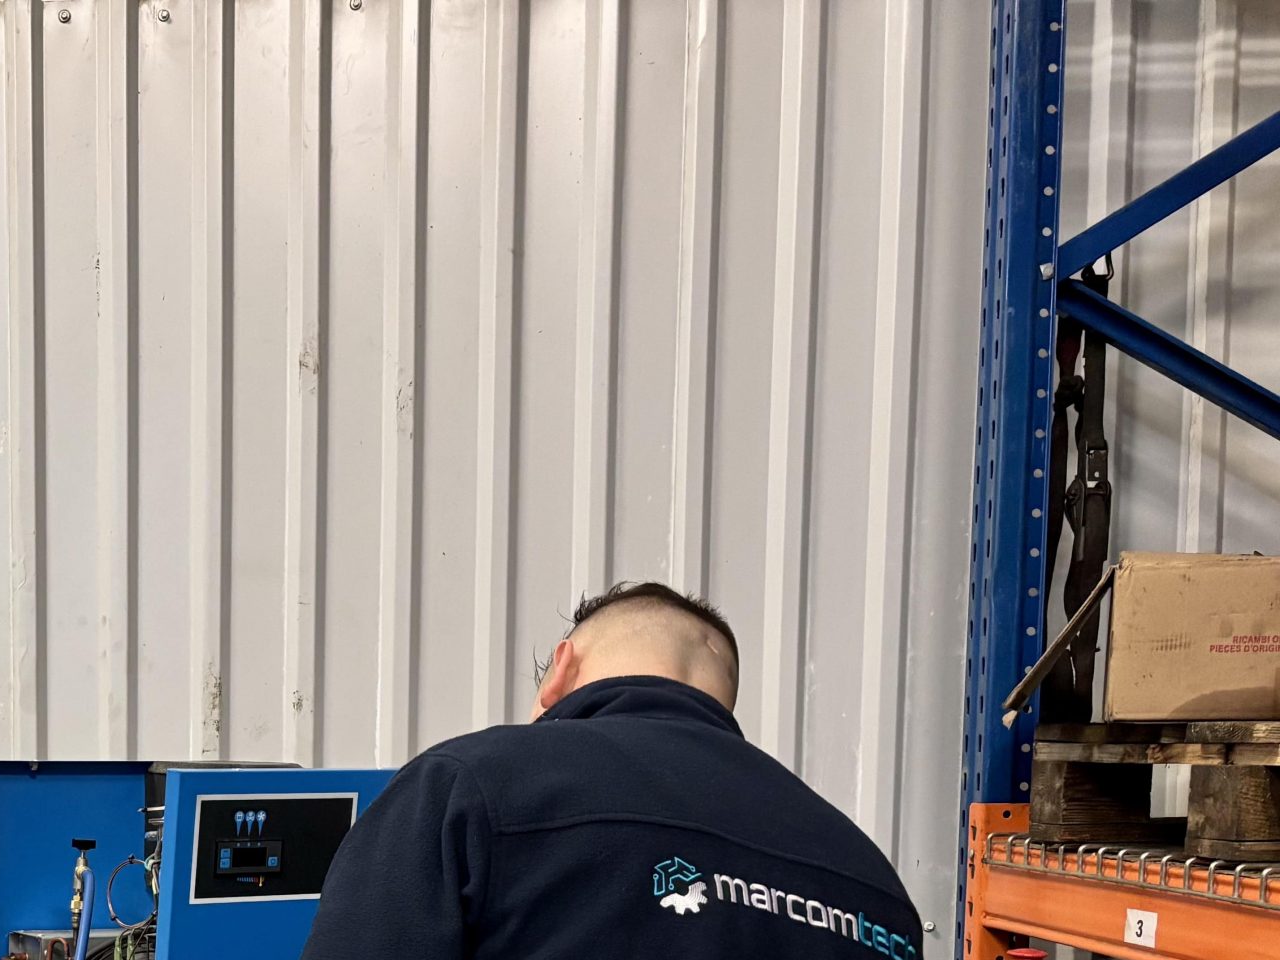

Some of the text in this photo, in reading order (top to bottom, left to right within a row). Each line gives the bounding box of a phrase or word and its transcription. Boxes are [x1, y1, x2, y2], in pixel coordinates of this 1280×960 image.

[1232, 635, 1280, 644] RICAMBI O
[1209, 644, 1241, 653] PIECES
[1135, 919, 1144, 938] 3
